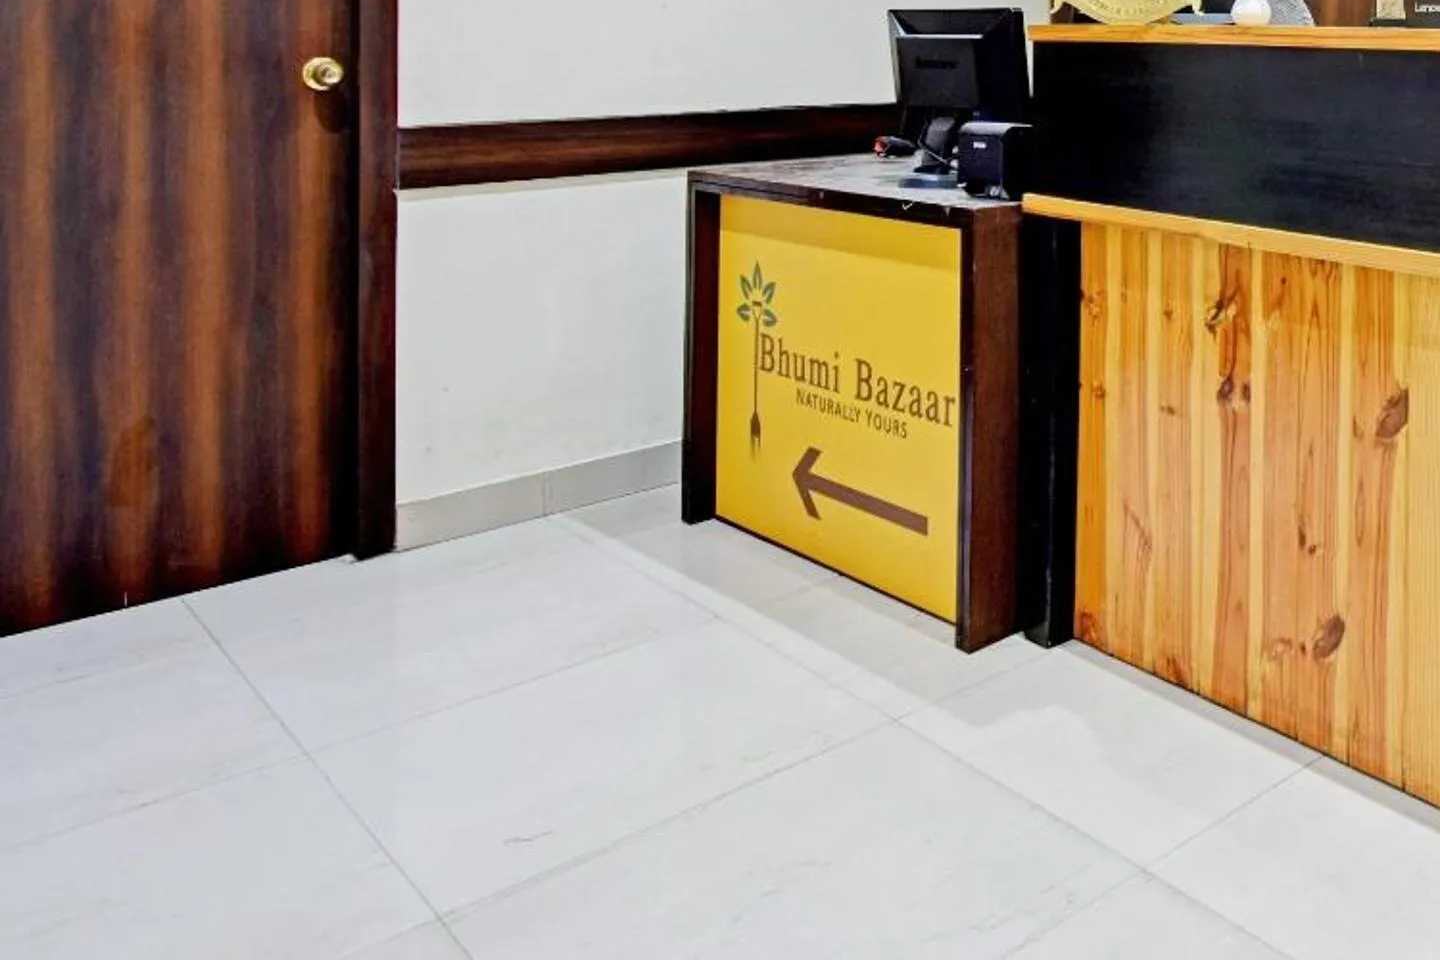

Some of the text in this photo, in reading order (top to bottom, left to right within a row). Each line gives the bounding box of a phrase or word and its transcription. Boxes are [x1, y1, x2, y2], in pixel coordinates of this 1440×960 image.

[760, 333, 956, 427] Bhumi Bazaar
[796, 387, 908, 439] NATURALLY YOURS
